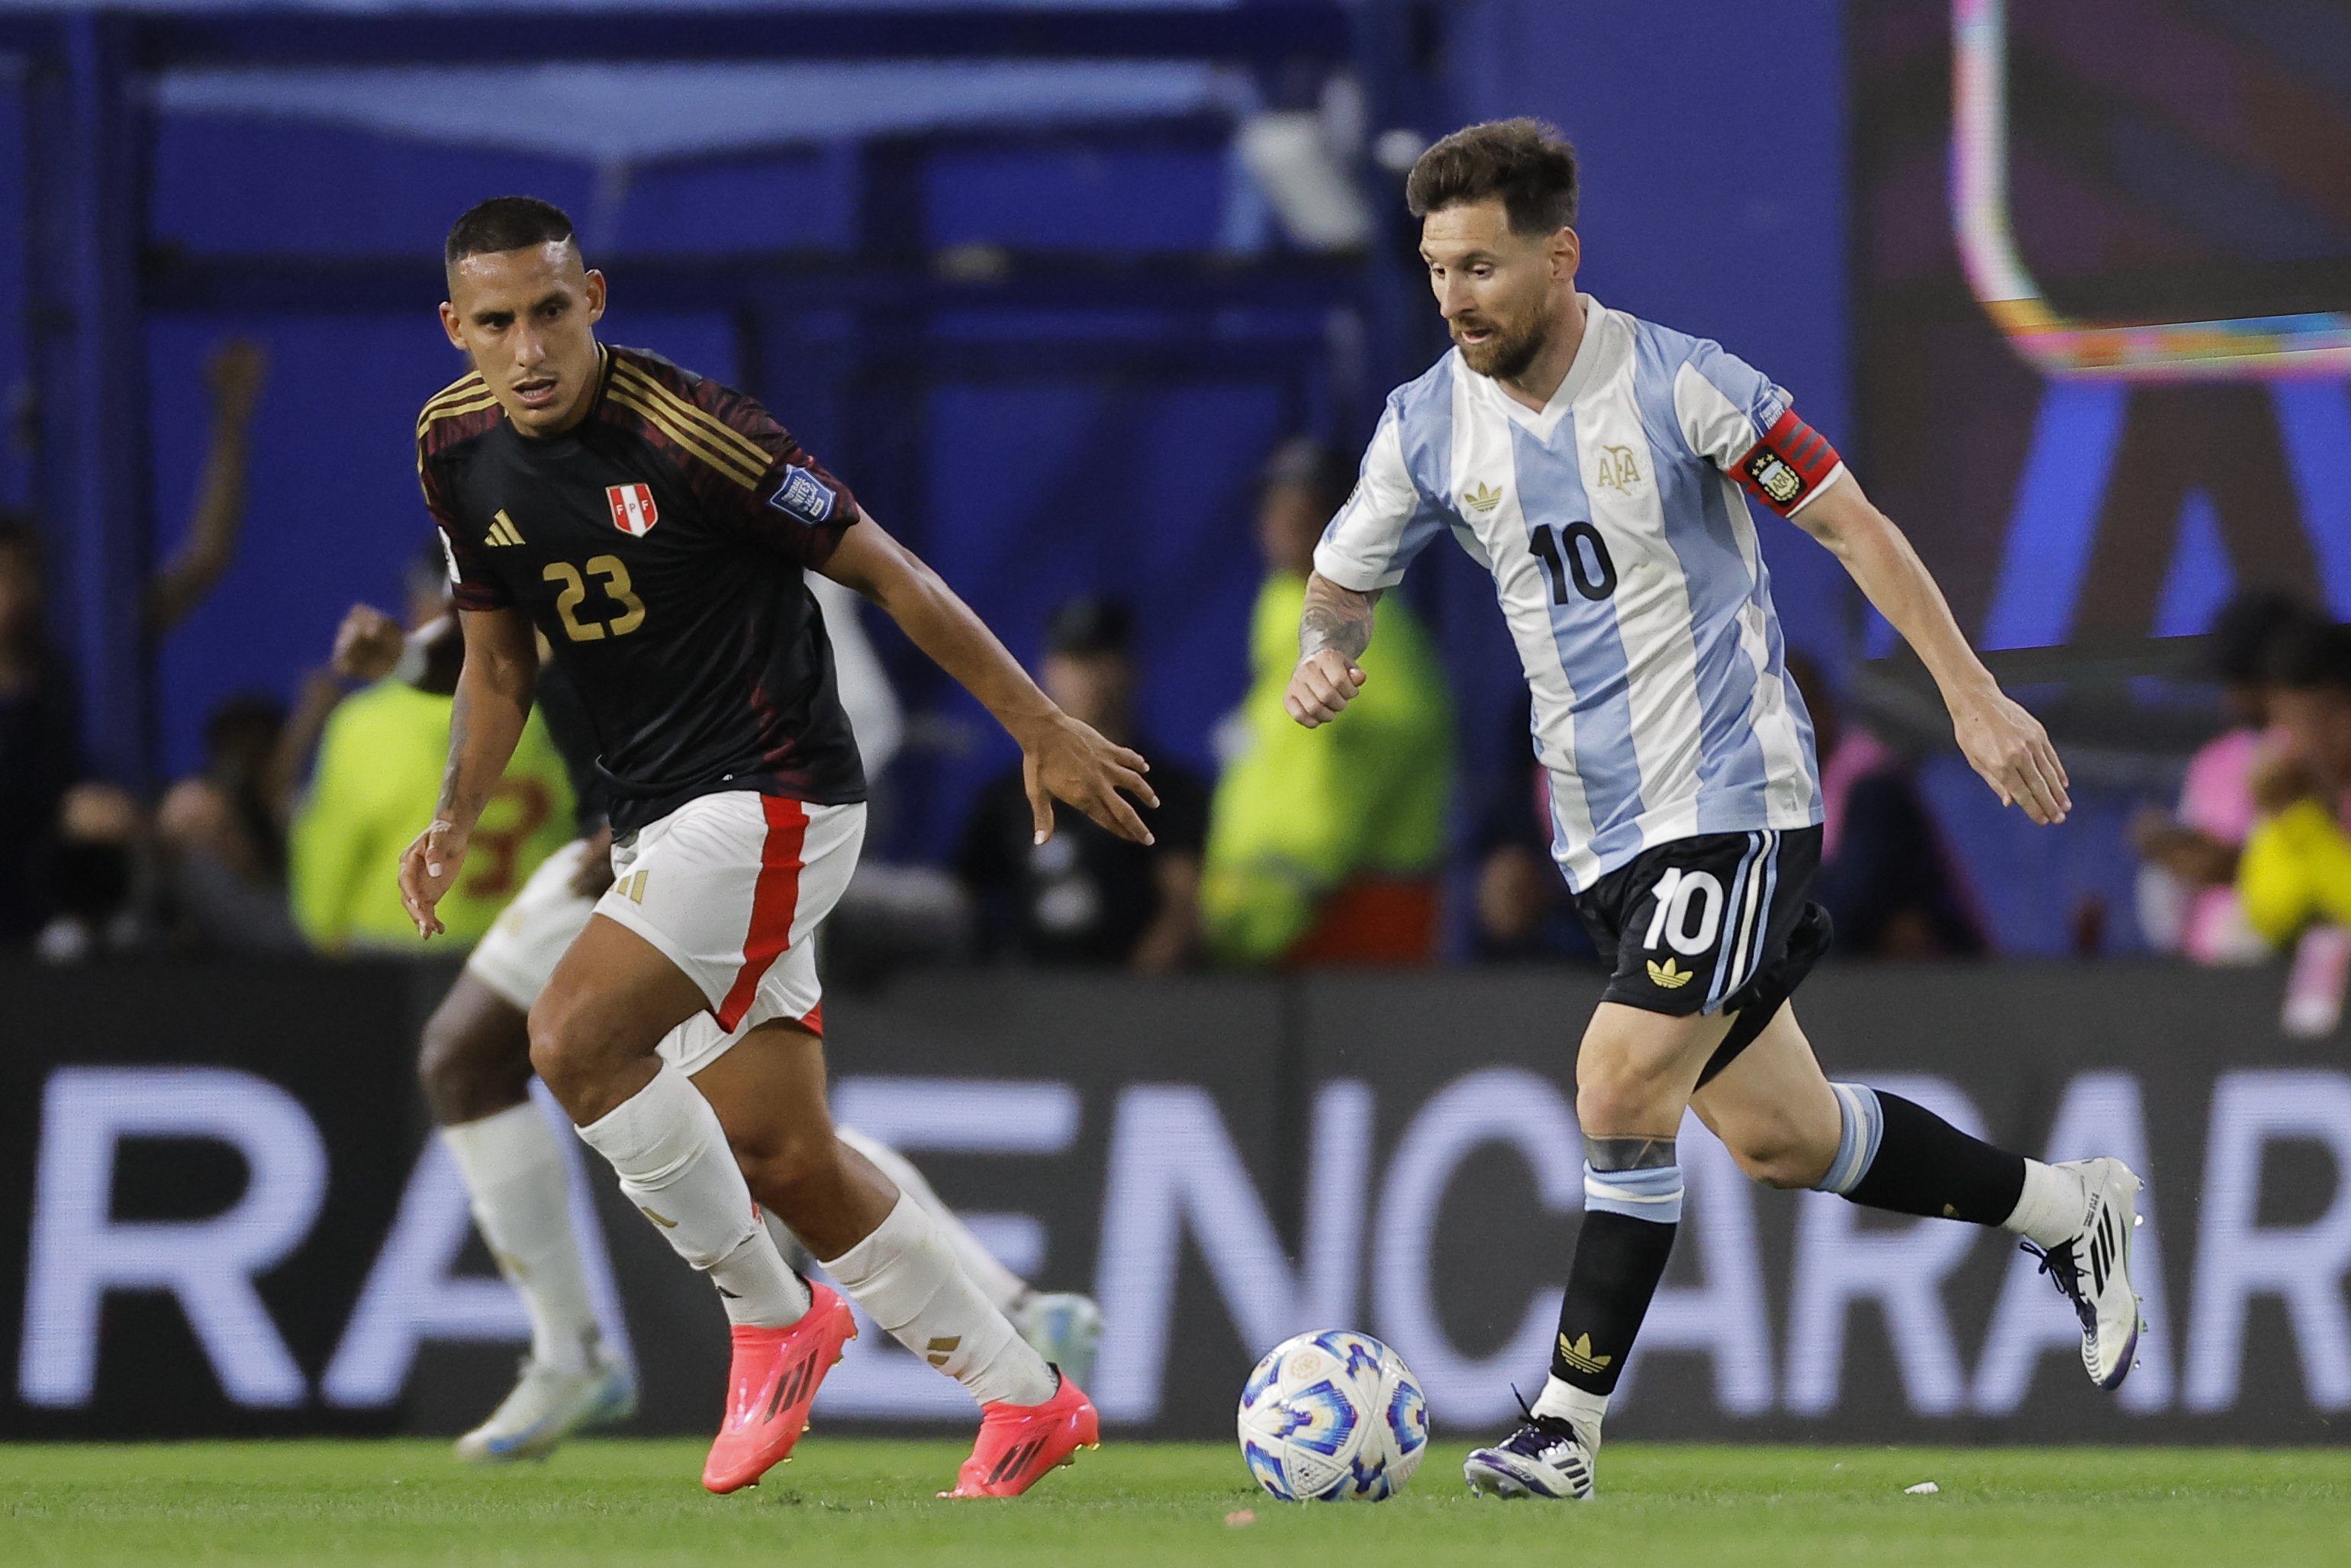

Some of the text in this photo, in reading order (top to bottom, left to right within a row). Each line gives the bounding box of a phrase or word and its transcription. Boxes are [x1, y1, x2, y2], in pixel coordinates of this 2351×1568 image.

[1596, 445, 1641, 496] AFA
[543, 554, 646, 642] 23
[1528, 521, 1617, 605] 10
[1643, 867, 1723, 955] 10
[17, 1064, 639, 1410] RA
